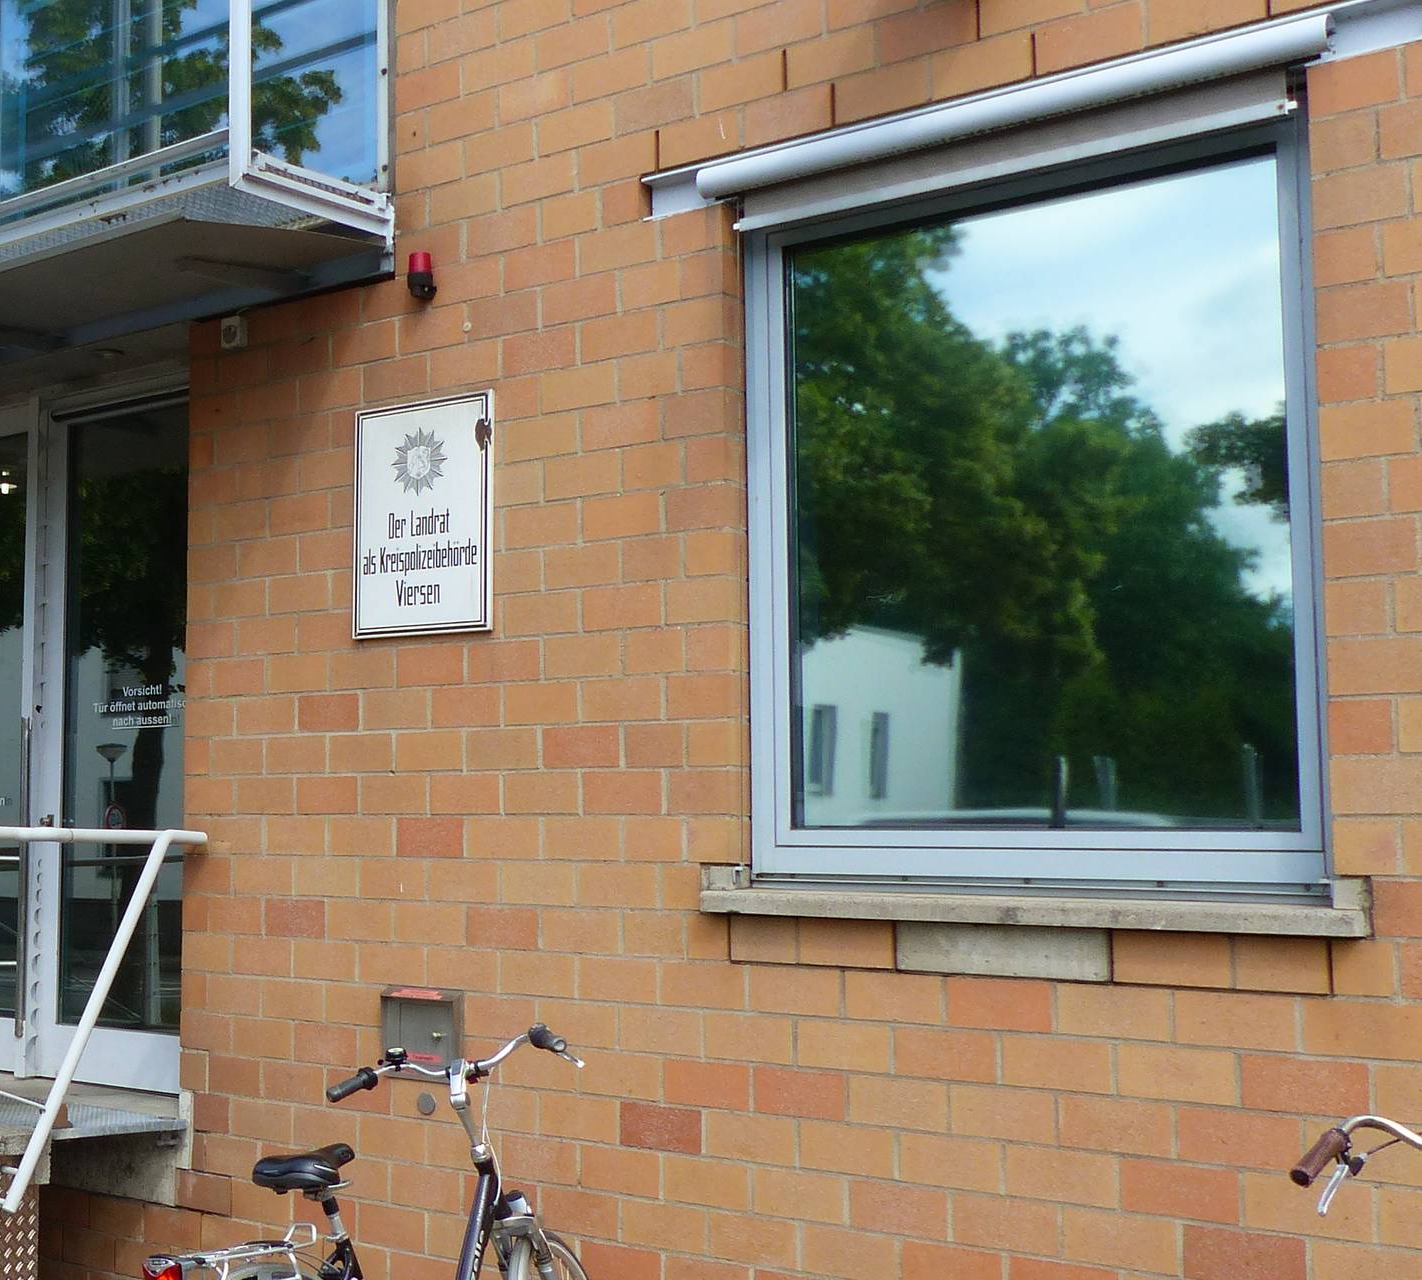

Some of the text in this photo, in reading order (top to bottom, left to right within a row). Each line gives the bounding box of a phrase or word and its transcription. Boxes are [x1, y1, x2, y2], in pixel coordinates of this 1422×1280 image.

[388, 507, 450, 539] Der Landrat
[363, 538, 477, 577] als Kreispolizeibehörde
[395, 579, 440, 607] Viersen
[122, 684, 162, 697] Vorsicht!
[92, 702, 108, 713] Tür
[109, 700, 136, 713] öffnet
[112, 713, 172, 727] nach aussen!
